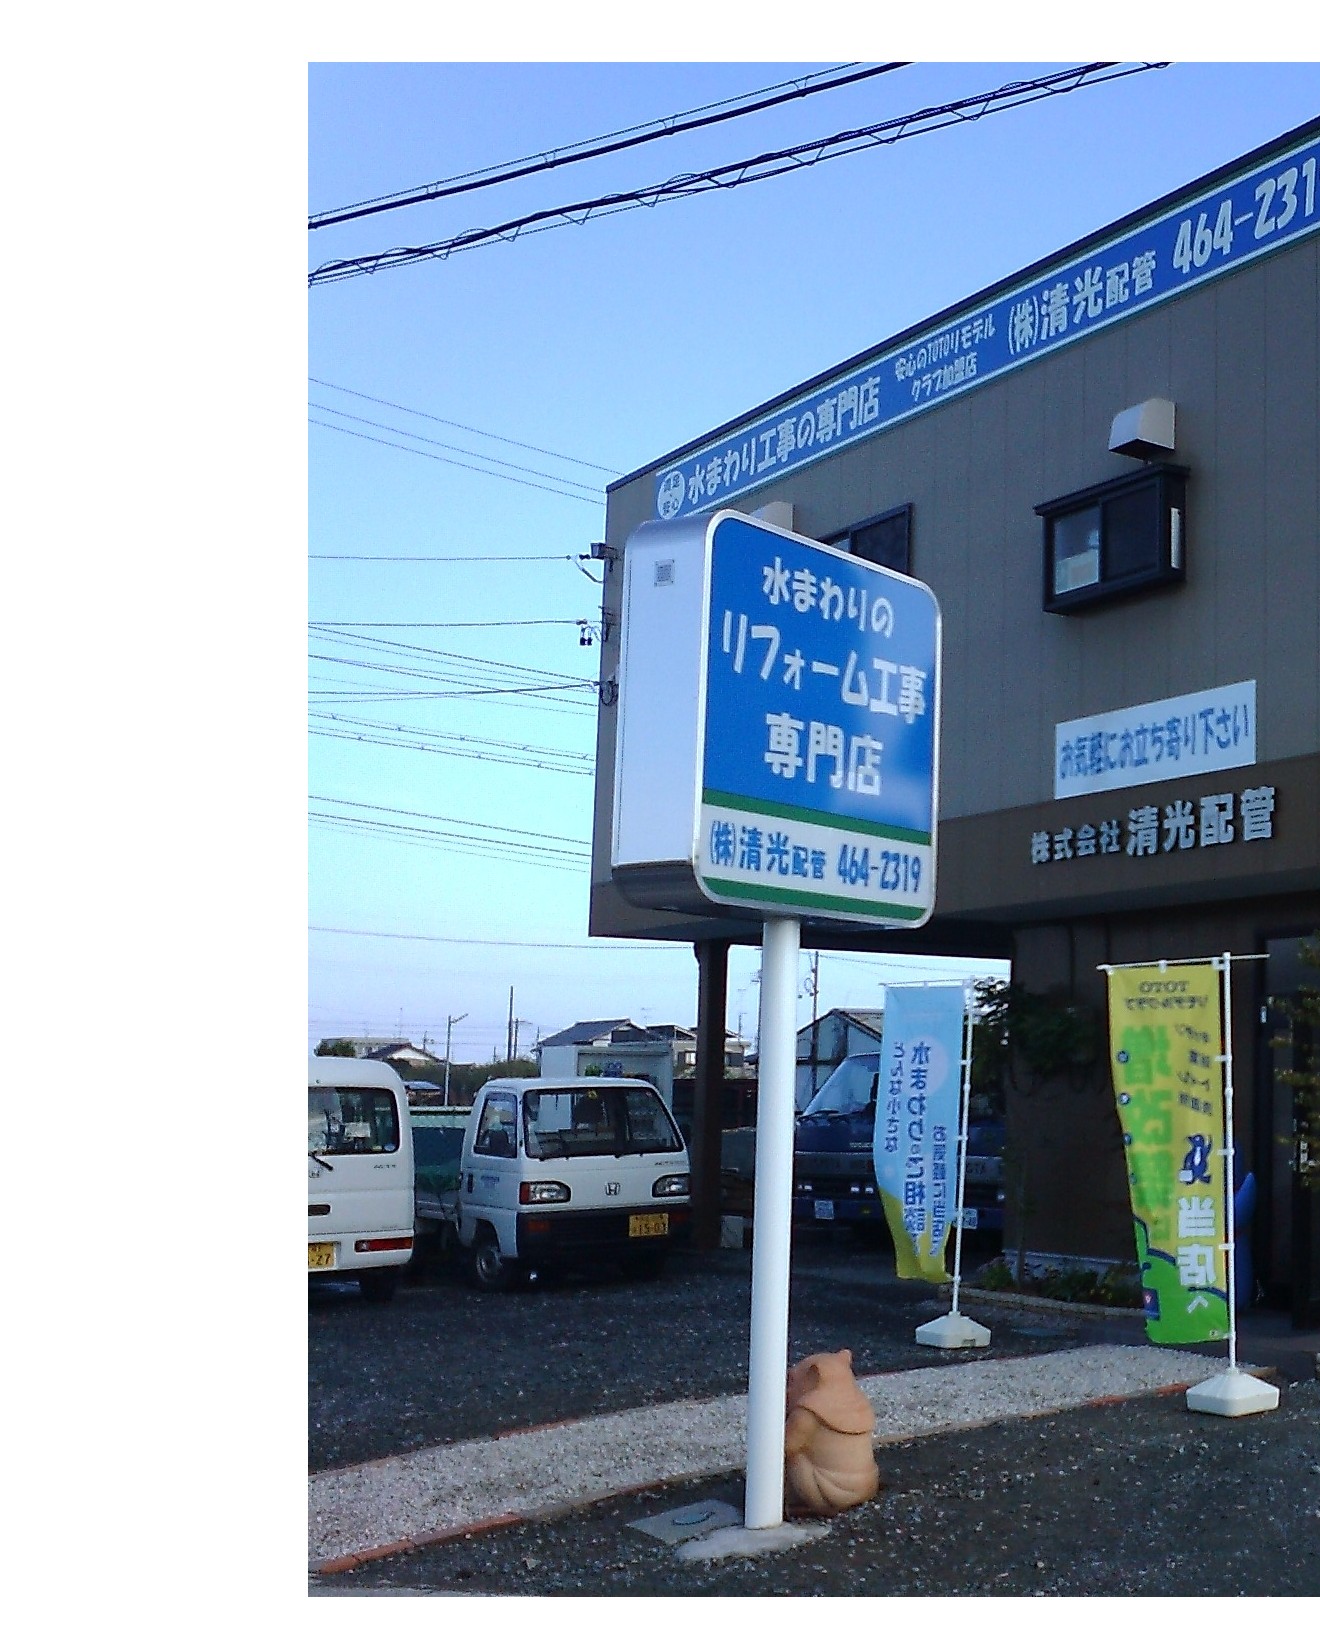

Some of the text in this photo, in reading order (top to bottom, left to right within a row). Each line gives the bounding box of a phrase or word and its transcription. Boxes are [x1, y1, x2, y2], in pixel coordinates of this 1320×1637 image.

[688, 376, 880, 504] 水まわり工事の専門店
[762, 556, 894, 639] 水まわりの
[722, 608, 926, 725] リフォーム工事
[763, 711, 884, 797] 専門店
[1059, 704, 1250, 780] お気軽にお立ち寄り下さい
[836, 844, 921, 893] 464-2319
